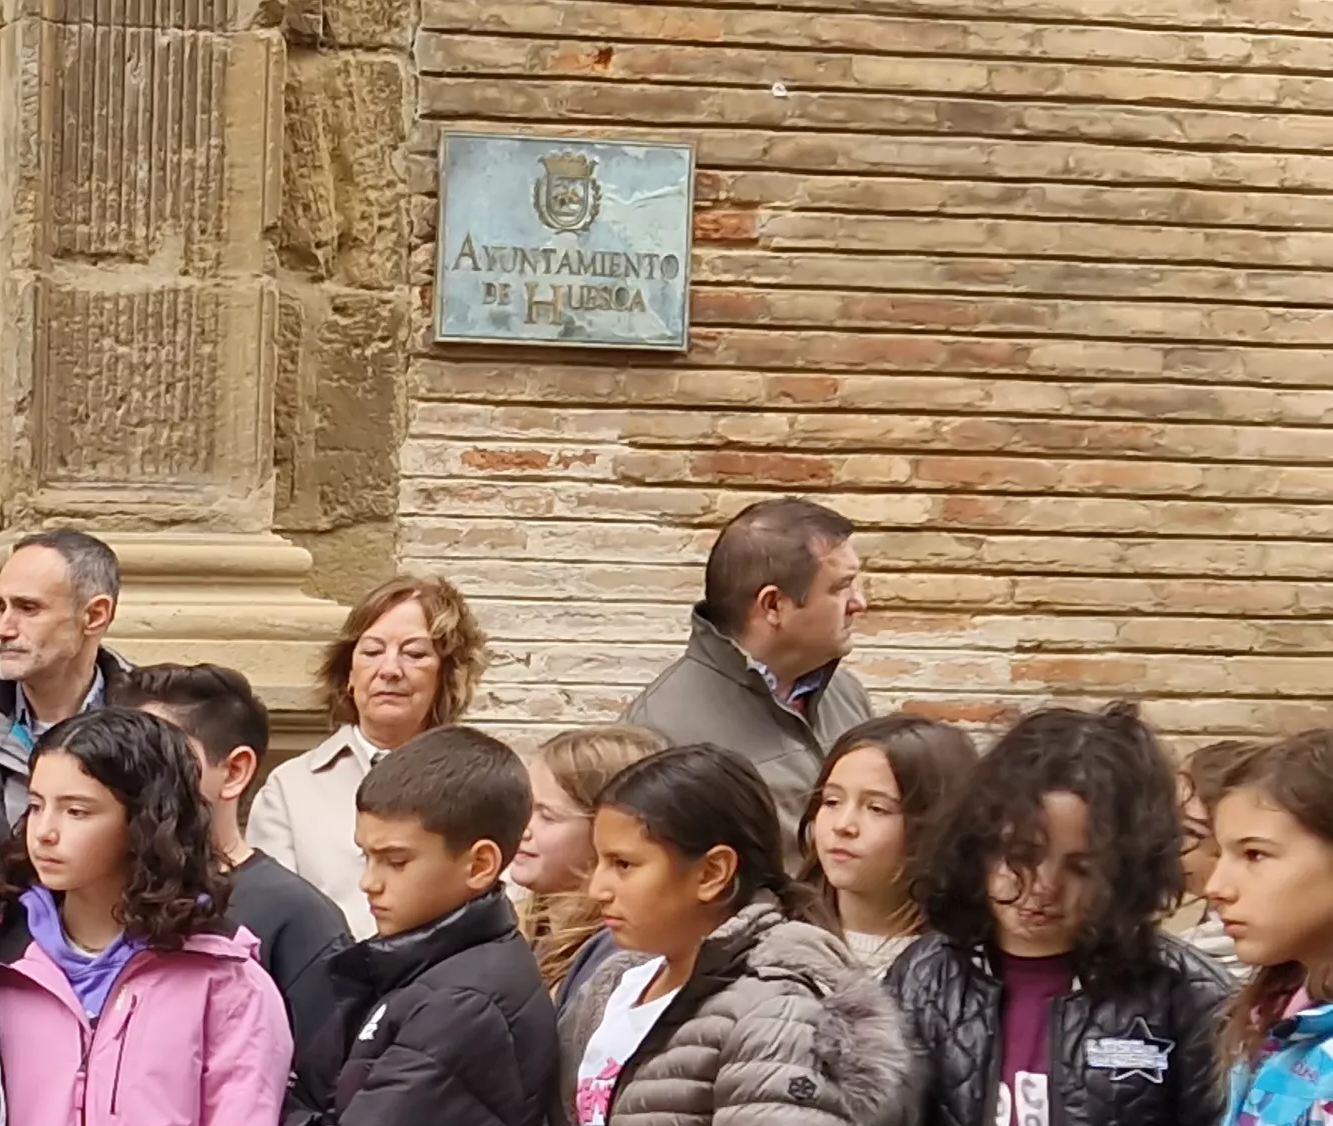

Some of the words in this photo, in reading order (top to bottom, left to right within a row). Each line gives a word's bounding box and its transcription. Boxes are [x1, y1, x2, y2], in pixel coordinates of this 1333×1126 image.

[451, 231, 680, 281] AYUNTAMIENTO
[482, 282, 512, 306] DE
[523, 281, 647, 326] HUESCA
